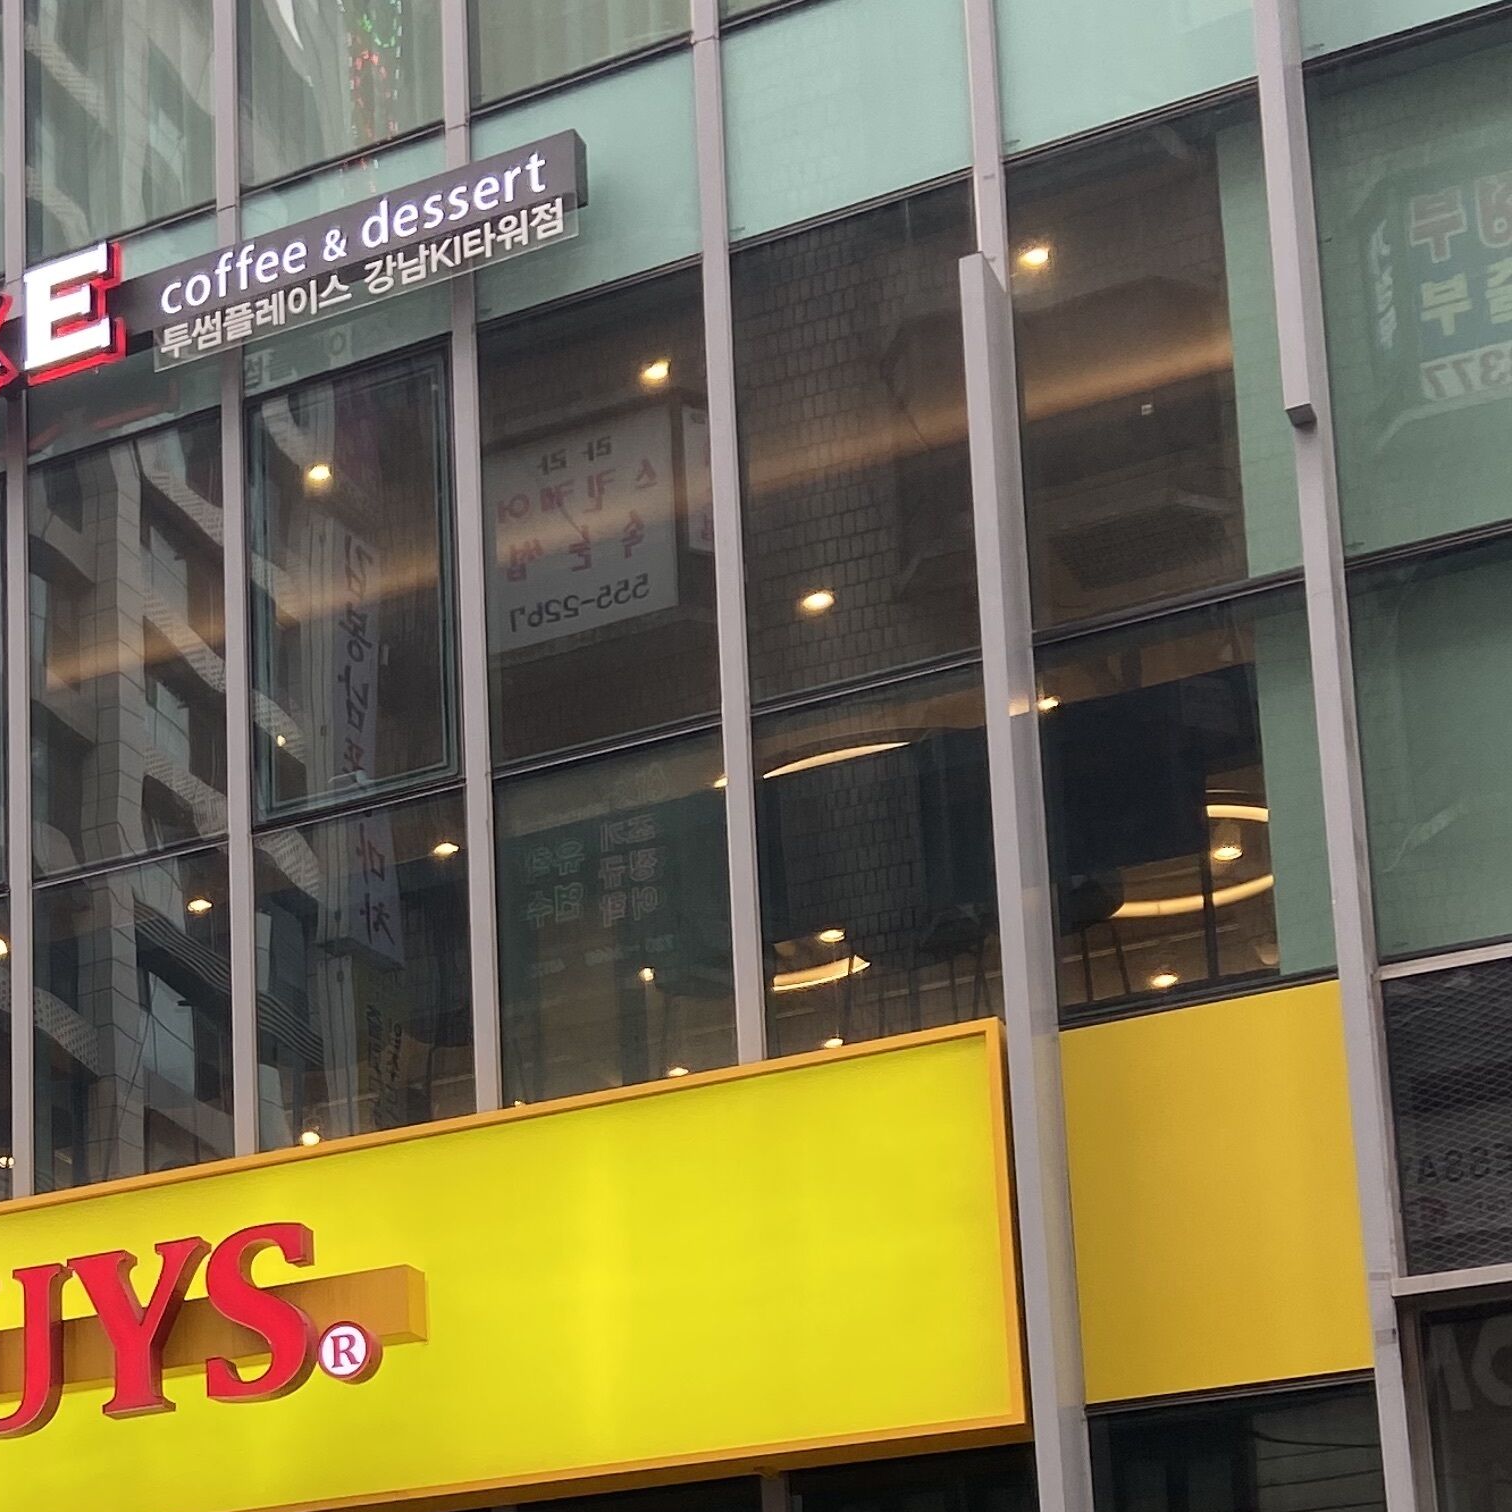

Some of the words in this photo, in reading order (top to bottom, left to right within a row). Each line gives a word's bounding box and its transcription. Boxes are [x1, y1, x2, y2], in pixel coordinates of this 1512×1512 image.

[159, 239, 308, 314] coffee
[322, 227, 348, 262] &
[362, 151, 547, 249] dessert
[160, 274, 352, 358] 투썸플레이스
[364, 198, 565, 294] 강남KI타워점
